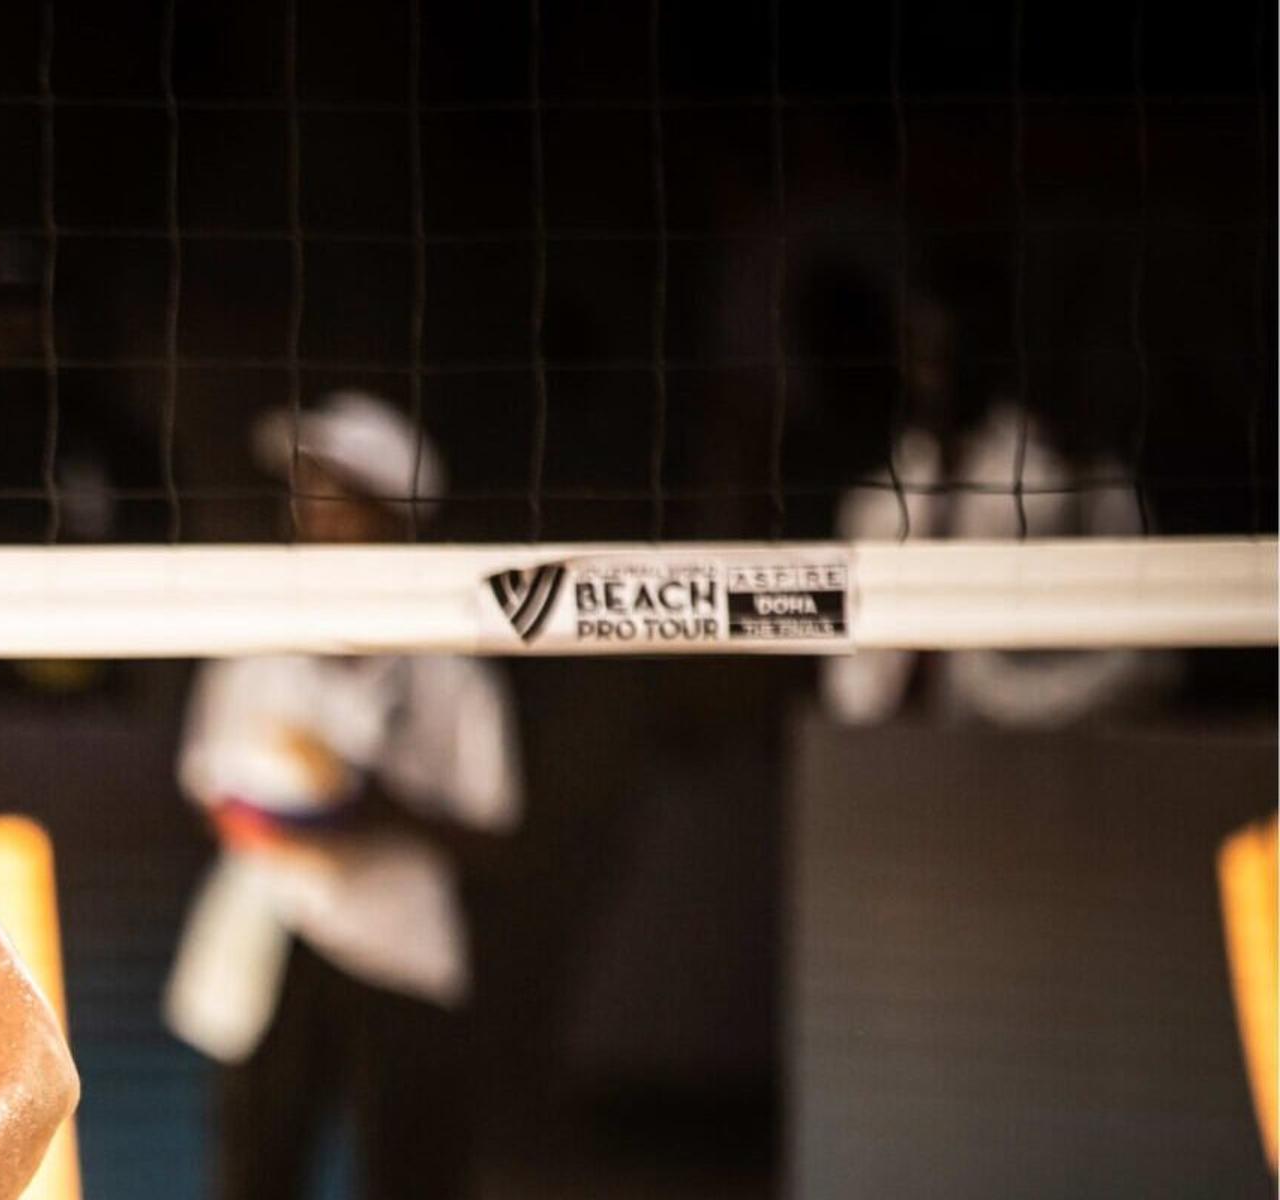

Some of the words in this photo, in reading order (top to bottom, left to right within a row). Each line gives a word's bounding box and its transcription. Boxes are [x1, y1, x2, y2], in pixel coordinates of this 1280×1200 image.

[576, 581, 716, 614] BEACH
[754, 595, 817, 615] DOHA
[577, 620, 637, 641] PRO
[644, 619, 719, 640] TOUR
